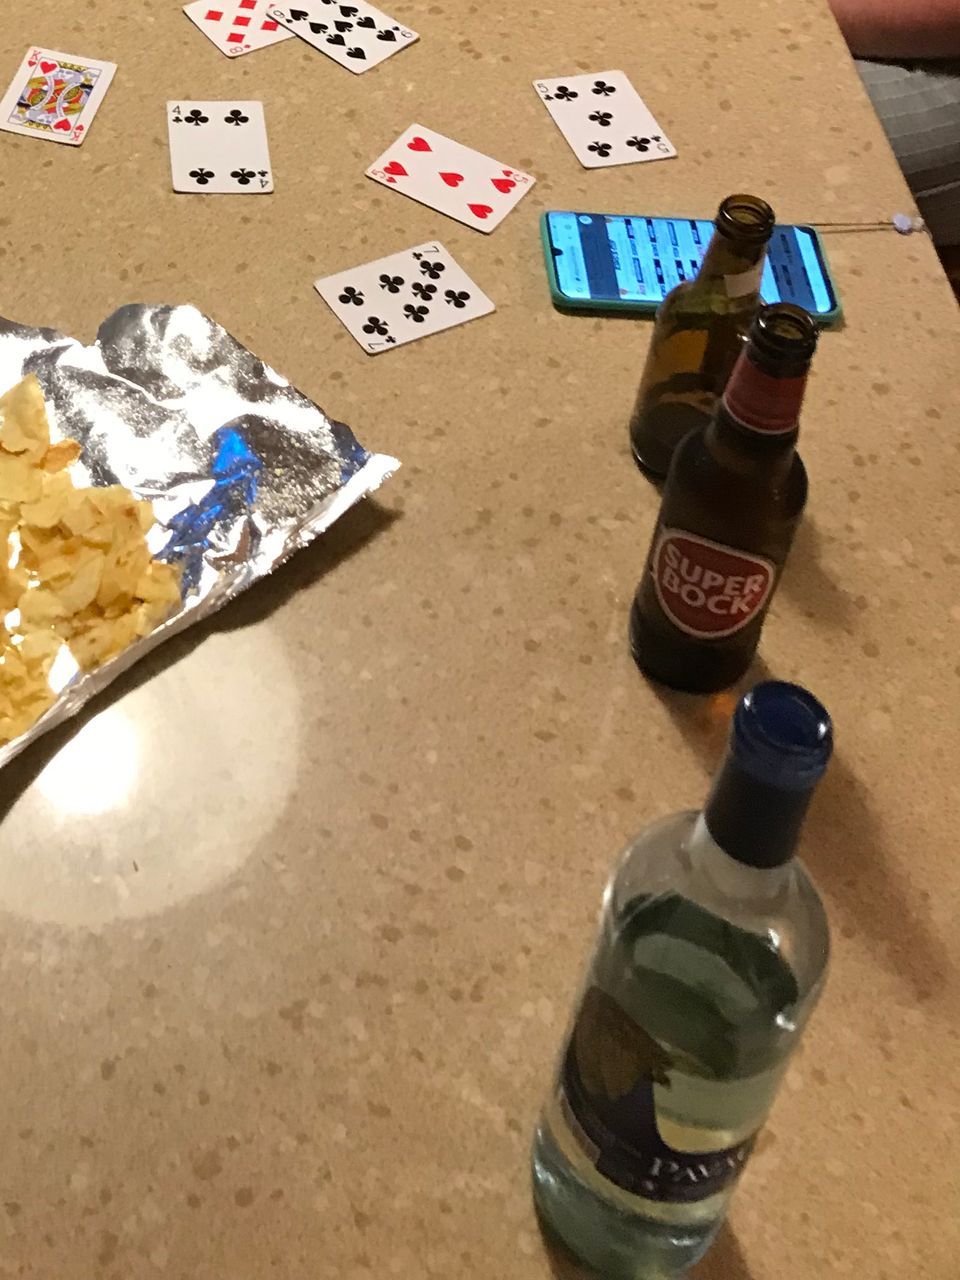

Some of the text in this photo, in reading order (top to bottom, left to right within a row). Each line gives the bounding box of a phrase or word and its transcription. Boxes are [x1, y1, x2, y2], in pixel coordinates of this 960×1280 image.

[172, 104, 182, 116] 4
[260, 178, 270, 189] 4
[664, 543, 766, 596] SUPER
[662, 566, 755, 615] BOCK
